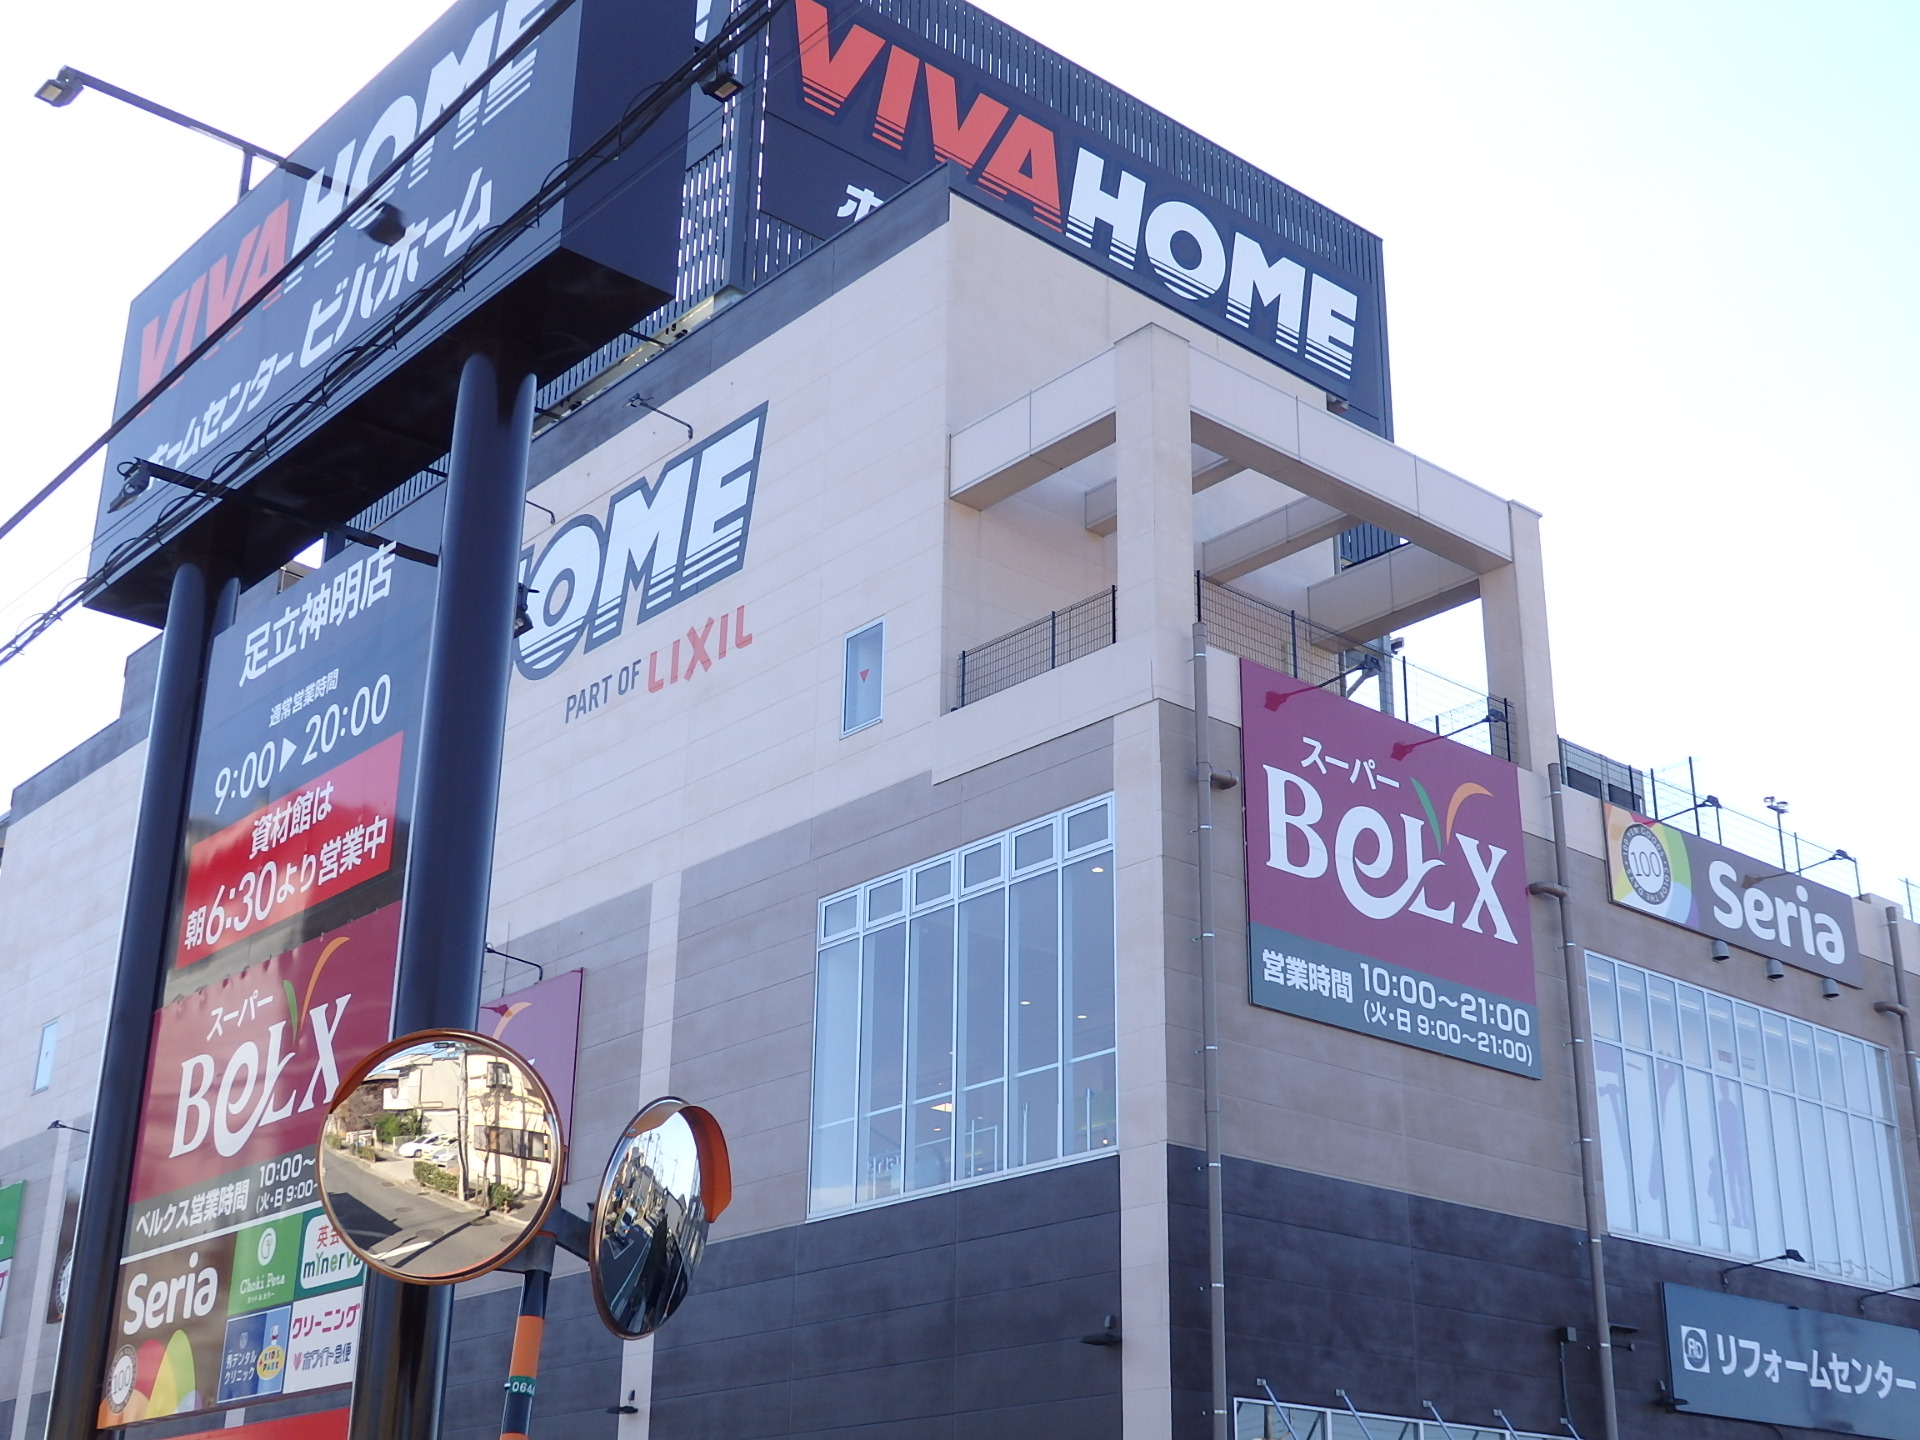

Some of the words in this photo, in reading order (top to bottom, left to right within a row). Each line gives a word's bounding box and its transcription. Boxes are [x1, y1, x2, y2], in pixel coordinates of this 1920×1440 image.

[135, 199, 289, 418] VIVA
[284, 0, 545, 293] HOME
[795, 0, 1062, 233] VIVA
[1066, 146, 1358, 380] HOME
[300, 167, 492, 368] ビバホーム
[518, 416, 761, 670] OME
[239, 540, 397, 687] 足立神明店
[269, 668, 339, 728] 通常営業時間
[565, 674, 613, 724] PART
[617, 659, 642, 696] OF
[648, 605, 753, 694] LIXIL
[214, 741, 276, 815] 9:00
[301, 674, 391, 766] 20:00
[1301, 736, 1400, 790] スーパー
[249, 780, 334, 860] 資材館は
[1630, 851, 1661, 877] 100
[1708, 860, 1846, 965] Seria
[1262, 949, 1354, 1004] 営業時間
[206, 990, 274, 1042] スーパー
[136, 1178, 250, 1238] ベルクス営業時間
[123, 1252, 218, 1335] Seria
[292, 1303, 360, 1339] クリーニング
[224, 1367, 255, 1385] クリニック
[302, 1342, 352, 1371] ホワイト急便
[1716, 1333, 1917, 1399] リフォームセンター
